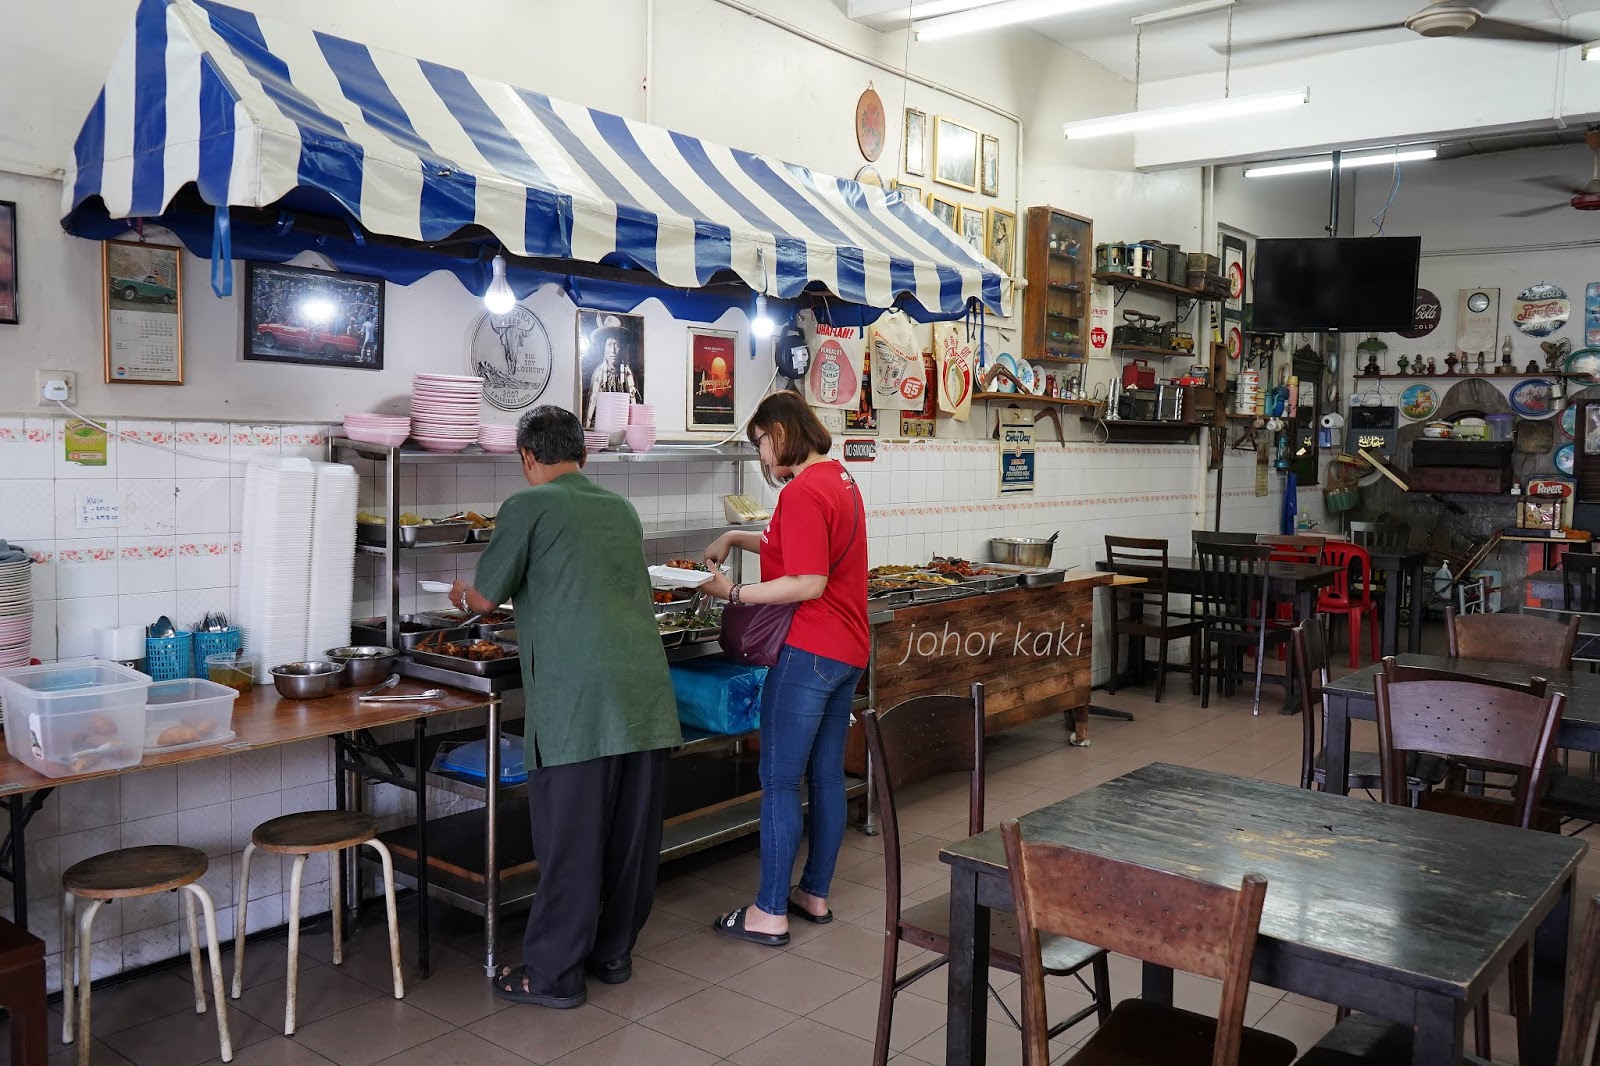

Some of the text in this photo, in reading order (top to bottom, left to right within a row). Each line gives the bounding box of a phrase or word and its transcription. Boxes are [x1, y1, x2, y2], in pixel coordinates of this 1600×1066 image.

[1521, 321, 1561, 331] SOLD HERE
[516, 366, 545, 374] COUNTRY
[503, 390, 519, 398] 2007
[903, 383, 919, 396] 65
[1018, 430, 1031, 445] Day
[845, 444, 853, 457] NO
